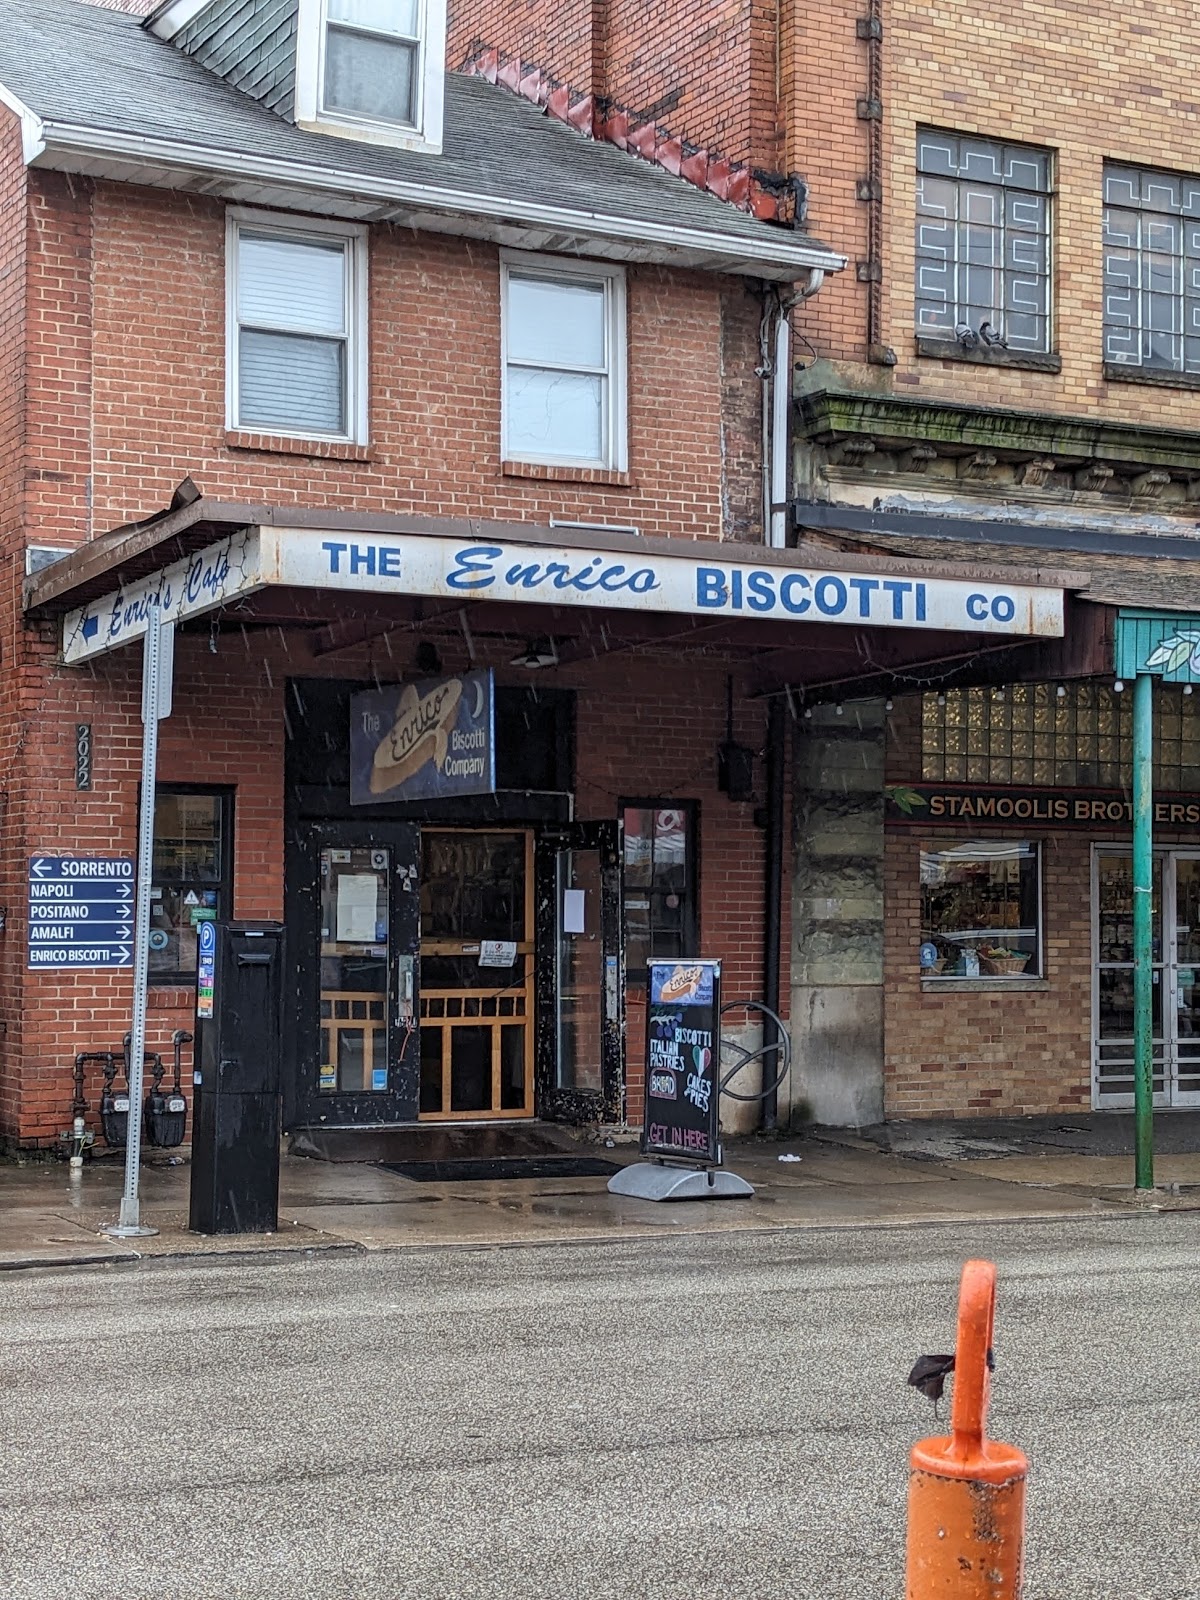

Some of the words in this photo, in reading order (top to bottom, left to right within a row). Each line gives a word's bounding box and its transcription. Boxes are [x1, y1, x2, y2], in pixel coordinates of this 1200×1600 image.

[322, 542, 401, 578] THE
[446, 547, 661, 593] Enrico
[696, 567, 926, 621] BISCOTTI
[362, 712, 380, 733] The
[391, 687, 449, 762] Enrico
[452, 727, 485, 751] Biscotti
[78, 725, 90, 789] 2022
[445, 754, 485, 779] Company
[929, 796, 1069, 819] STAMOOLIS
[1074, 800, 1200, 823] BROTERS
[61, 861, 132, 876] SORRENTO
[31, 885, 74, 897] NAPOLI
[31, 906, 89, 918] POSITANO
[31, 927, 74, 939] AMALFI
[30, 950, 67, 961] ENRICO
[68, 950, 110, 961] BISCOTTI
[650, 1039, 679, 1056] ITALIAN
[675, 1028, 712, 1047] BISCOTTI
[650, 1053, 685, 1072] PASTRIES
[652, 1075, 675, 1095] BREAD
[686, 1072, 711, 1097] CAKES
[689, 1090, 709, 1113] PIES
[649, 1122, 668, 1142] GET
[671, 1127, 682, 1145] IN
[683, 1128, 708, 1150] HERE
